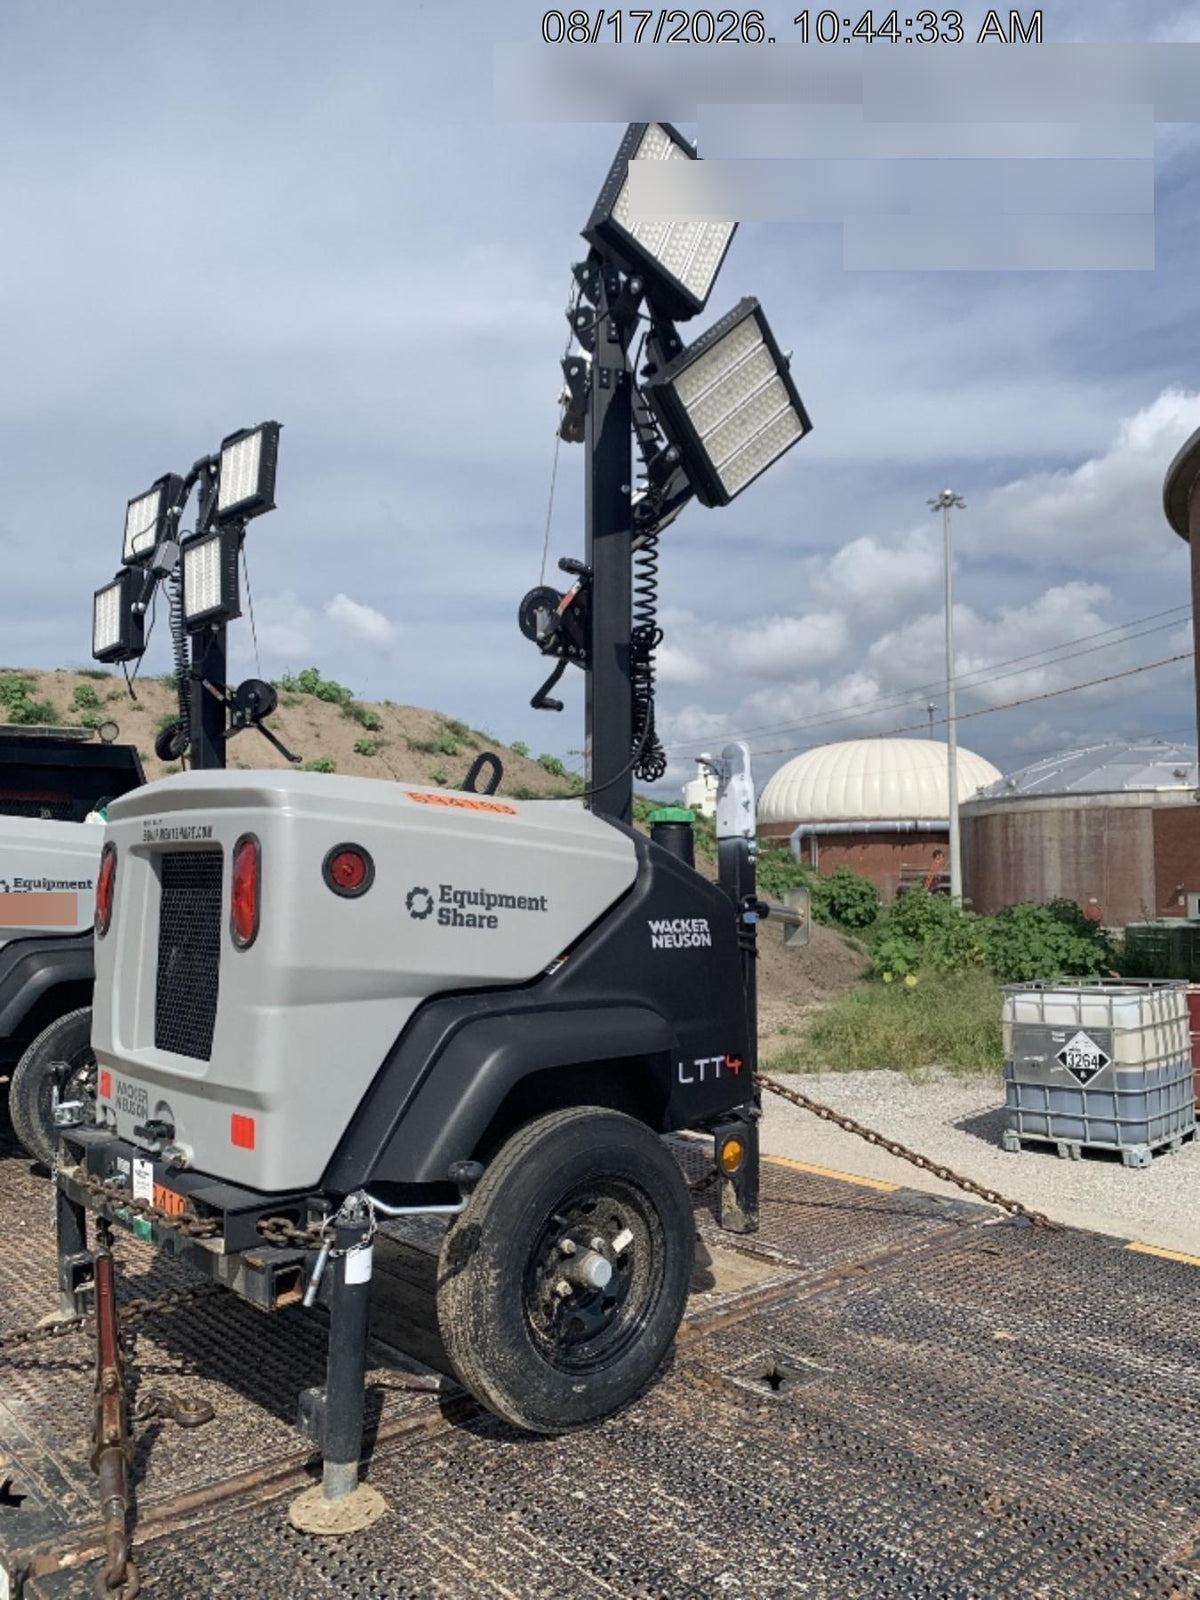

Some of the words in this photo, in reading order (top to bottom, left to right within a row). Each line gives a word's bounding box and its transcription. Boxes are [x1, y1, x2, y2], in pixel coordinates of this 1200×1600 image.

[13, 877, 93, 891] Equipment
[438, 884, 548, 912] Equipment
[437, 906, 498, 929] Share
[648, 918, 710, 934] WACKER
[651, 933, 712, 949] NEUSON
[679, 1055, 742, 1083] LTT4
[1067, 1052, 1098, 1069] 3264
